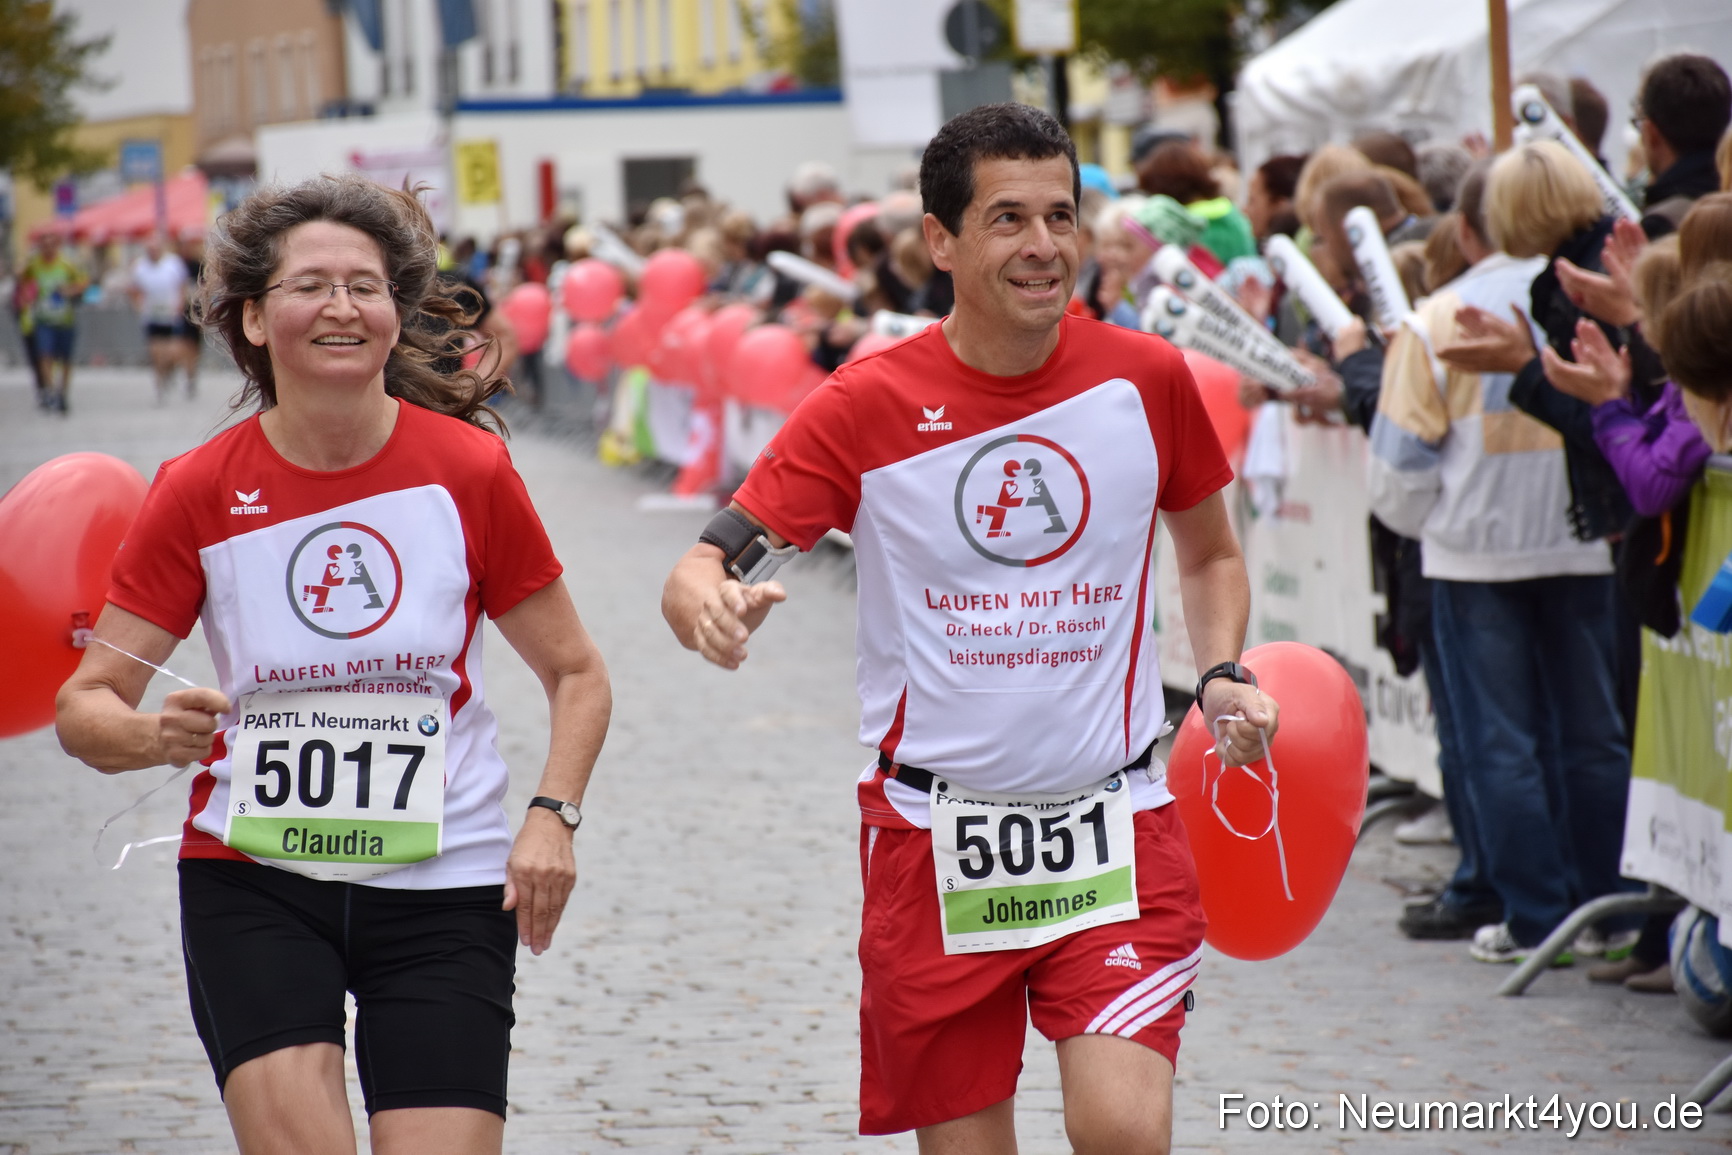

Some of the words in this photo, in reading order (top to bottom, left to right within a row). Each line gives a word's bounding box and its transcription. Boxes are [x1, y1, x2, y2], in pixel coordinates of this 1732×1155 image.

[917, 420, 953, 432] erima
[230, 503, 268, 515] erima
[924, 588, 1009, 611] LAUFEN
[1020, 590, 1063, 608] MIT
[1072, 582, 1124, 605] HERZ
[946, 623, 968, 637] Dr.
[971, 622, 1013, 637] Heck
[1016, 621, 1025, 638] /
[1029, 621, 1052, 635] Dr.
[1056, 616, 1106, 634] Röschl
[254, 663, 336, 683] LAUFEN
[346, 658, 385, 675] MIT
[396, 652, 446, 671] HERZ
[243, 712, 306, 730] PARTL
[311, 711, 410, 732] Neumarkt
[254, 739, 426, 811] 5017
[282, 827, 384, 857] Claudia
[956, 802, 1109, 880] 5051
[982, 889, 1098, 924] Johannes
[1104, 957, 1143, 971] adidas
